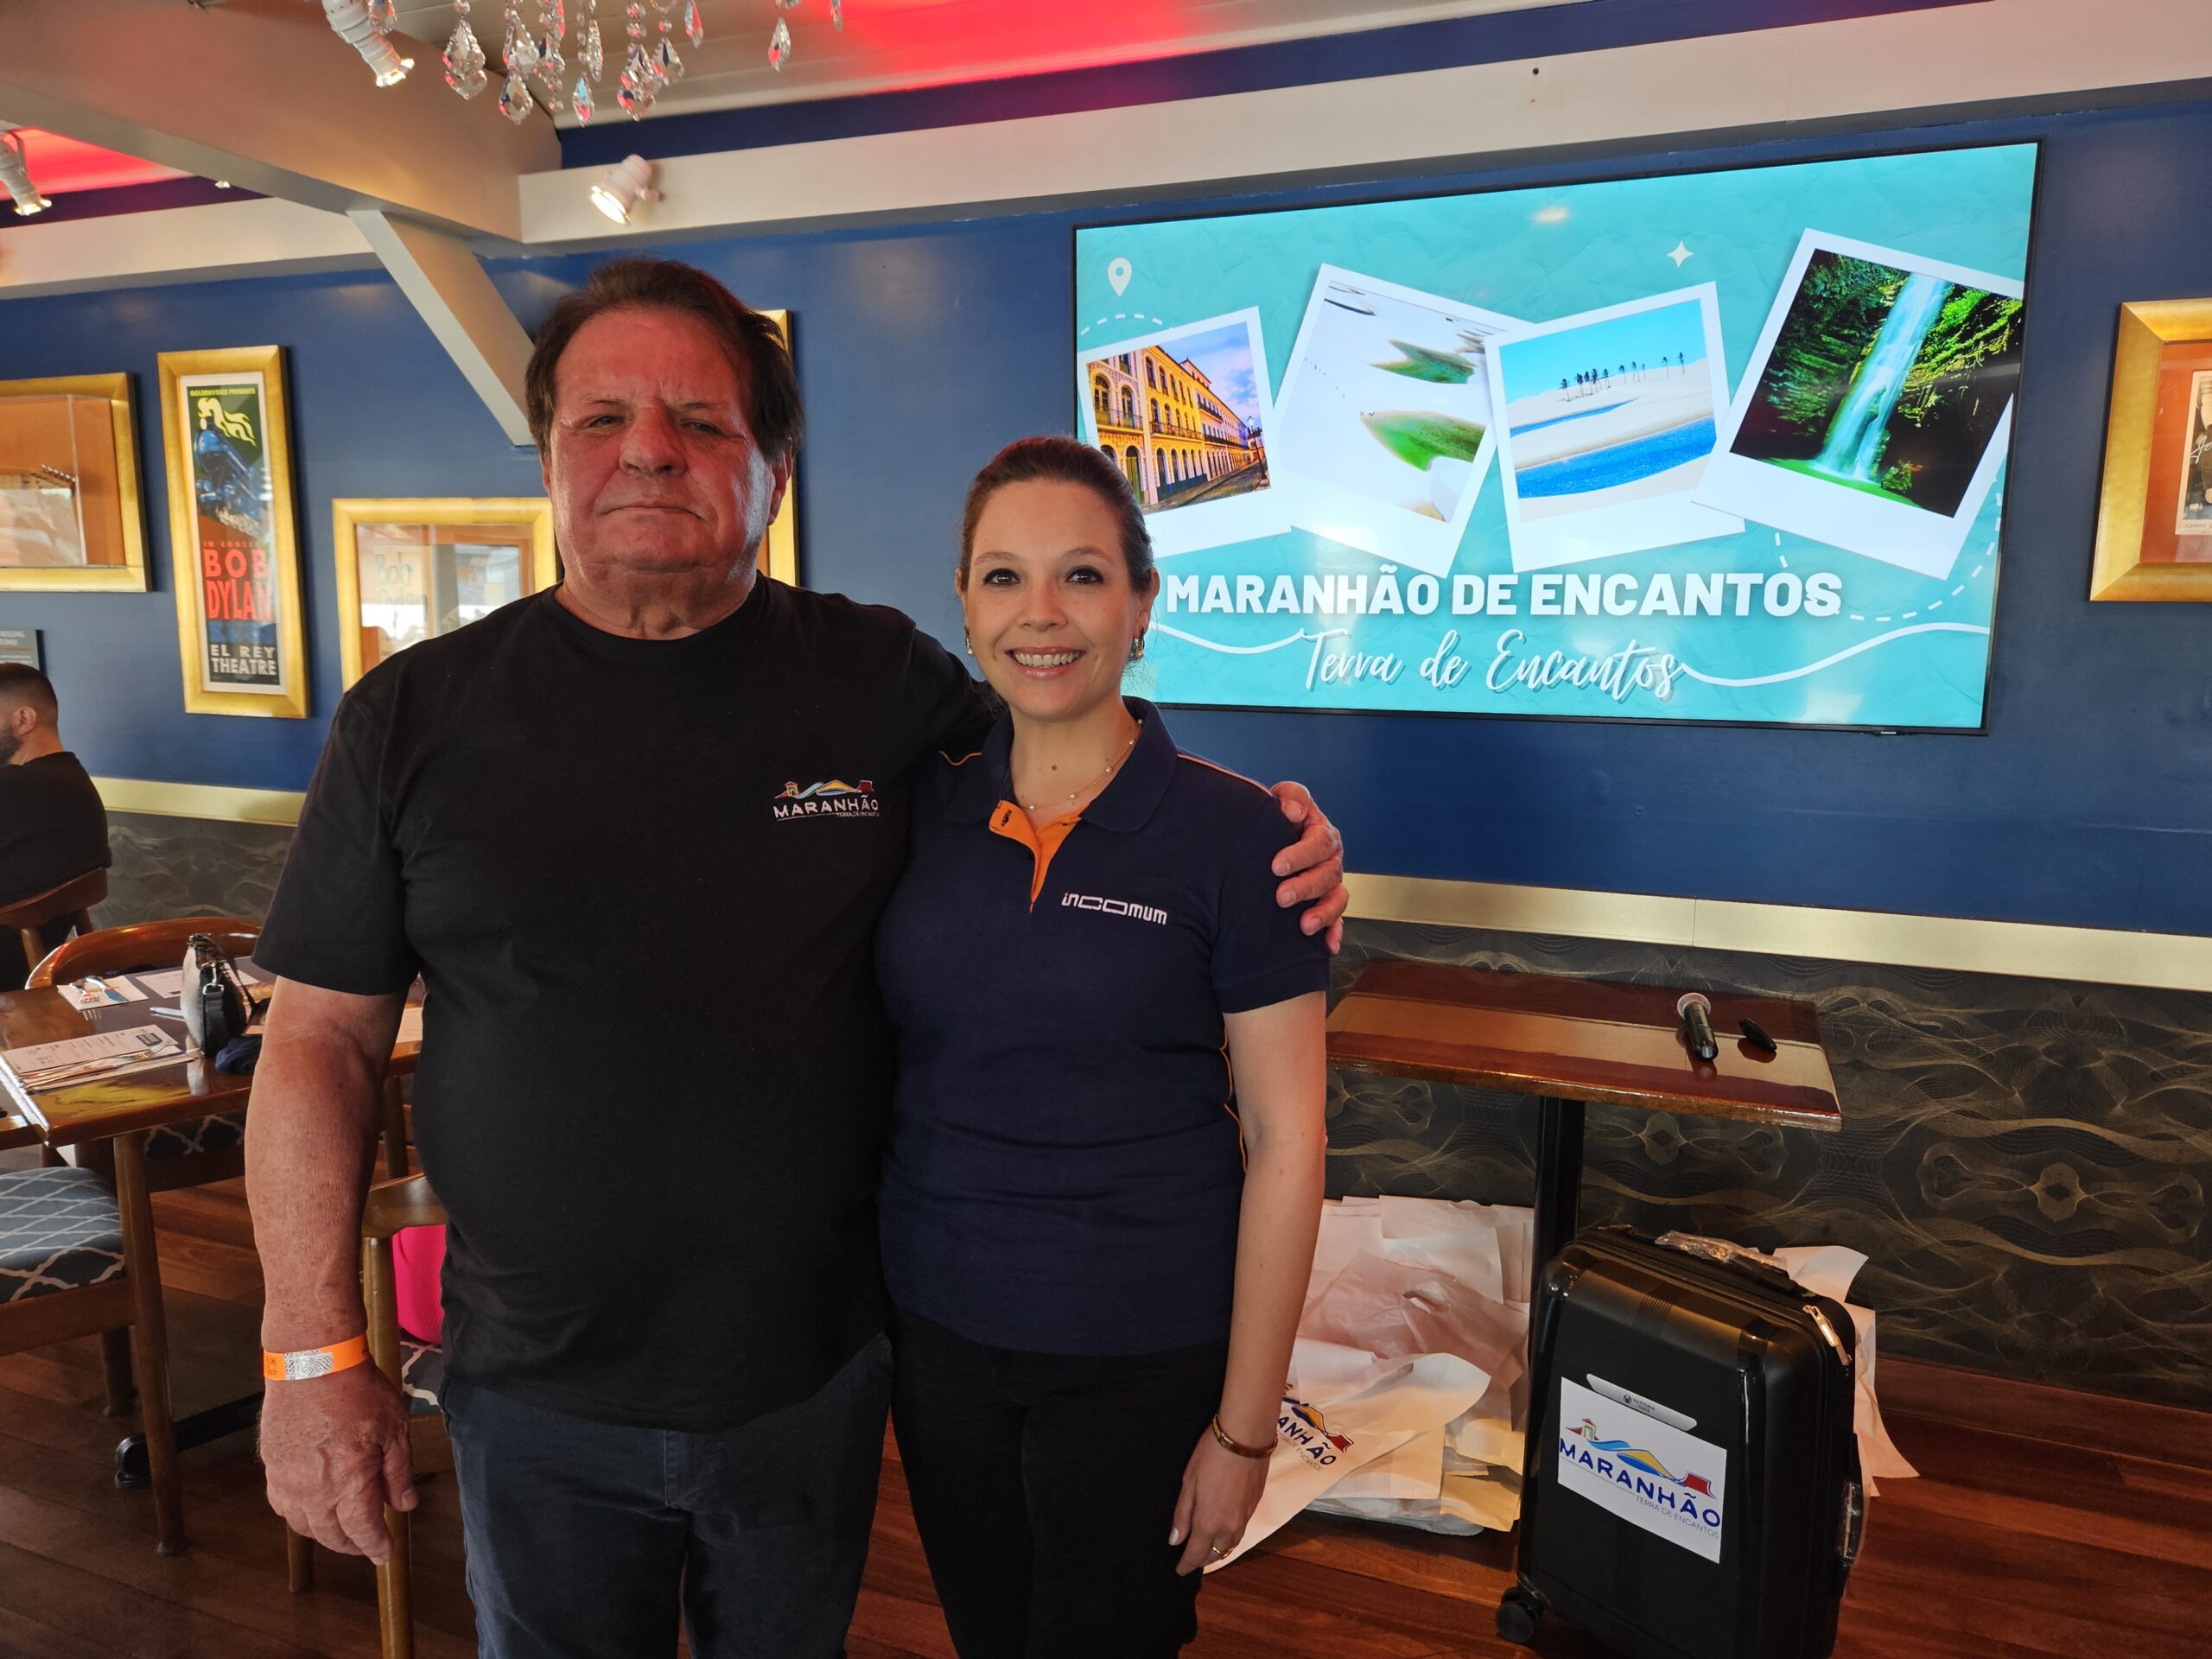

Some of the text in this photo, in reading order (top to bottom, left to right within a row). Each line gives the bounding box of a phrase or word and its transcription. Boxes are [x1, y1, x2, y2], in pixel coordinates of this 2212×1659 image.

[203, 549, 270, 578] BOB
[207, 578, 274, 622] DYLAN
[1166, 564, 1843, 617] MARANHÃO DE ENCANTOS
[210, 644, 276, 658] EL REY
[211, 658, 277, 676] THEATRE
[1300, 627, 1681, 701] Terra de Encantos
[772, 795, 880, 819] MARANHÃO
[1278, 1416, 1338, 1465] ANHÃO
[1559, 1437, 1721, 1528] MARANHÃO
[1637, 1496, 1719, 1540] TERRA DE ENCANTOS
